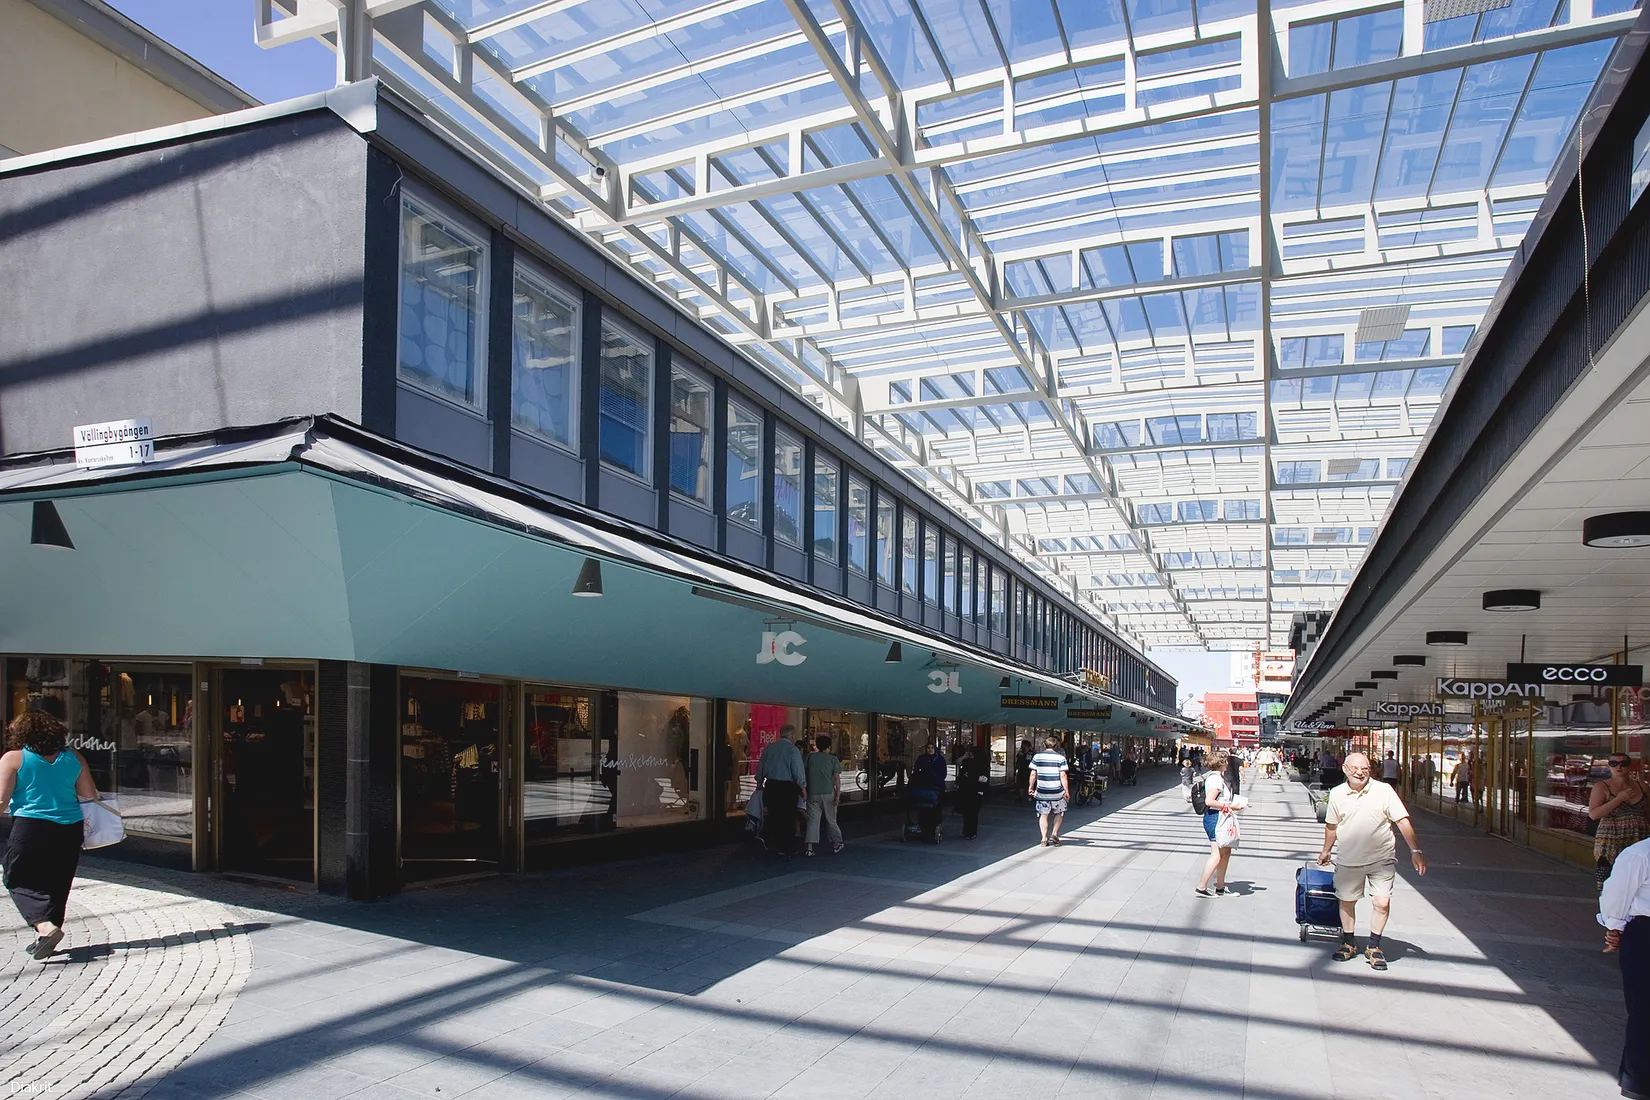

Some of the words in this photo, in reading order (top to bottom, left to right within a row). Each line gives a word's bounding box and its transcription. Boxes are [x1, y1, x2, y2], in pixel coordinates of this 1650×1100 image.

[80, 425, 149, 443] Vällingbygången
[129, 444, 150, 459] 1-17
[756, 630, 808, 666] JC
[1542, 667, 1608, 681] ecco
[1002, 698, 1057, 707] DRESSMANN
[1376, 701, 1446, 716] KappAhl
[759, 730, 777, 744] Real
